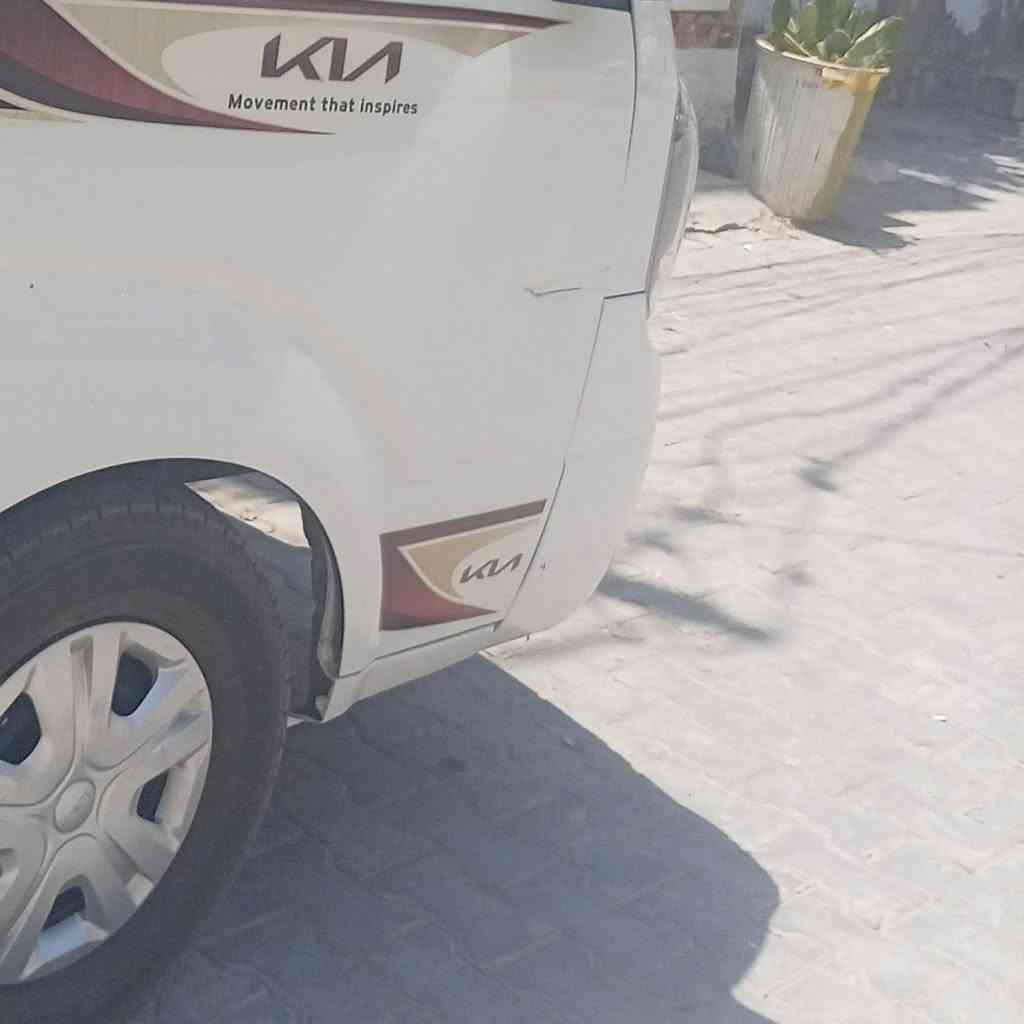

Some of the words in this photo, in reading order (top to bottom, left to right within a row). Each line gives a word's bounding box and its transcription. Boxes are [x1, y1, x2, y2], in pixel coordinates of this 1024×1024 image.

[261, 32, 403, 84] KIA
[228, 94, 316, 111] Movement
[322, 98, 355, 112] that
[360, 99, 418, 116] inspires
[459, 553, 523, 584] KIA
